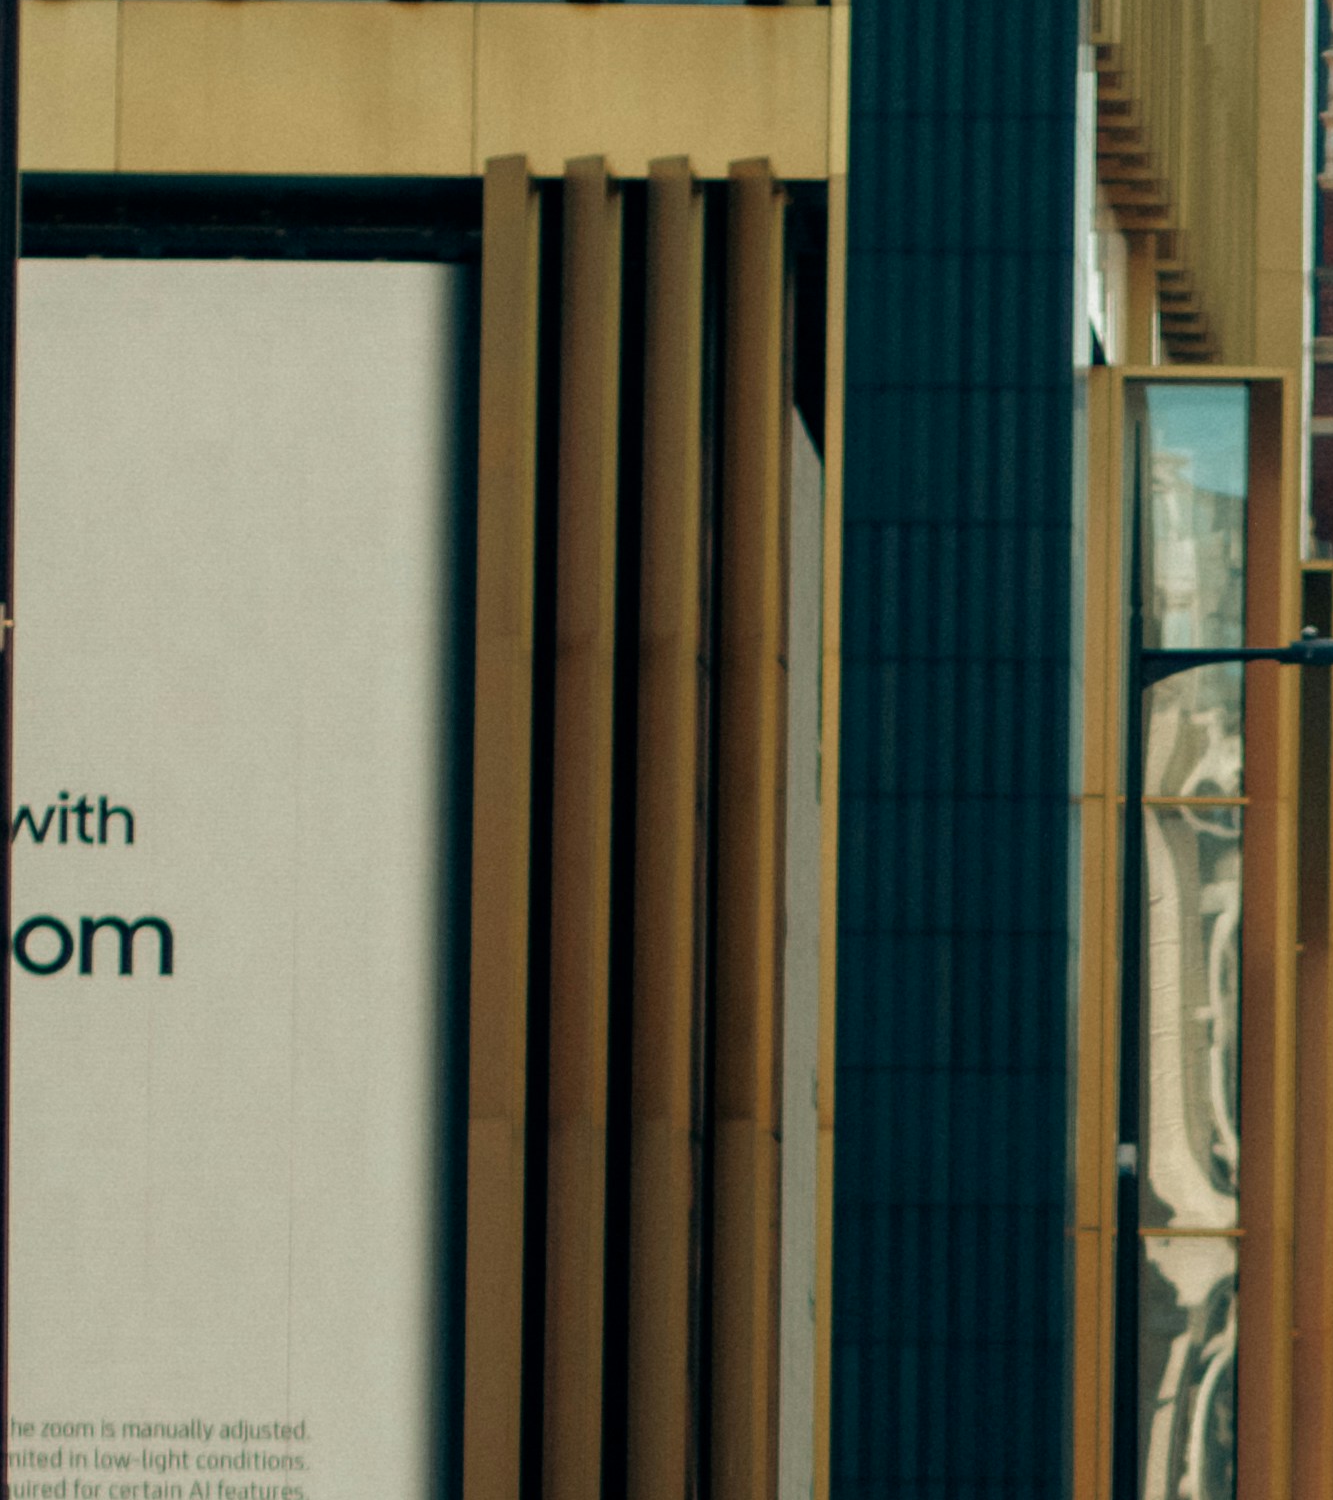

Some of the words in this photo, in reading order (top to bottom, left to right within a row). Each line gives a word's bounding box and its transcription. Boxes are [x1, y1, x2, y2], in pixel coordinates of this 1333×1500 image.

[11, 790, 134, 845] with
[41, 1421, 94, 1438] zoom
[101, 1418, 116, 1438] is
[122, 1417, 214, 1442] manually
[219, 1418, 311, 1443] adjusted.
[69, 1448, 87, 1469] in
[94, 1447, 188, 1475] low-light
[195, 1449, 311, 1471] conditions.
[73, 1477, 102, 1500] for
[108, 1479, 183, 1500] certain
[217, 1478, 310, 1500] features.
